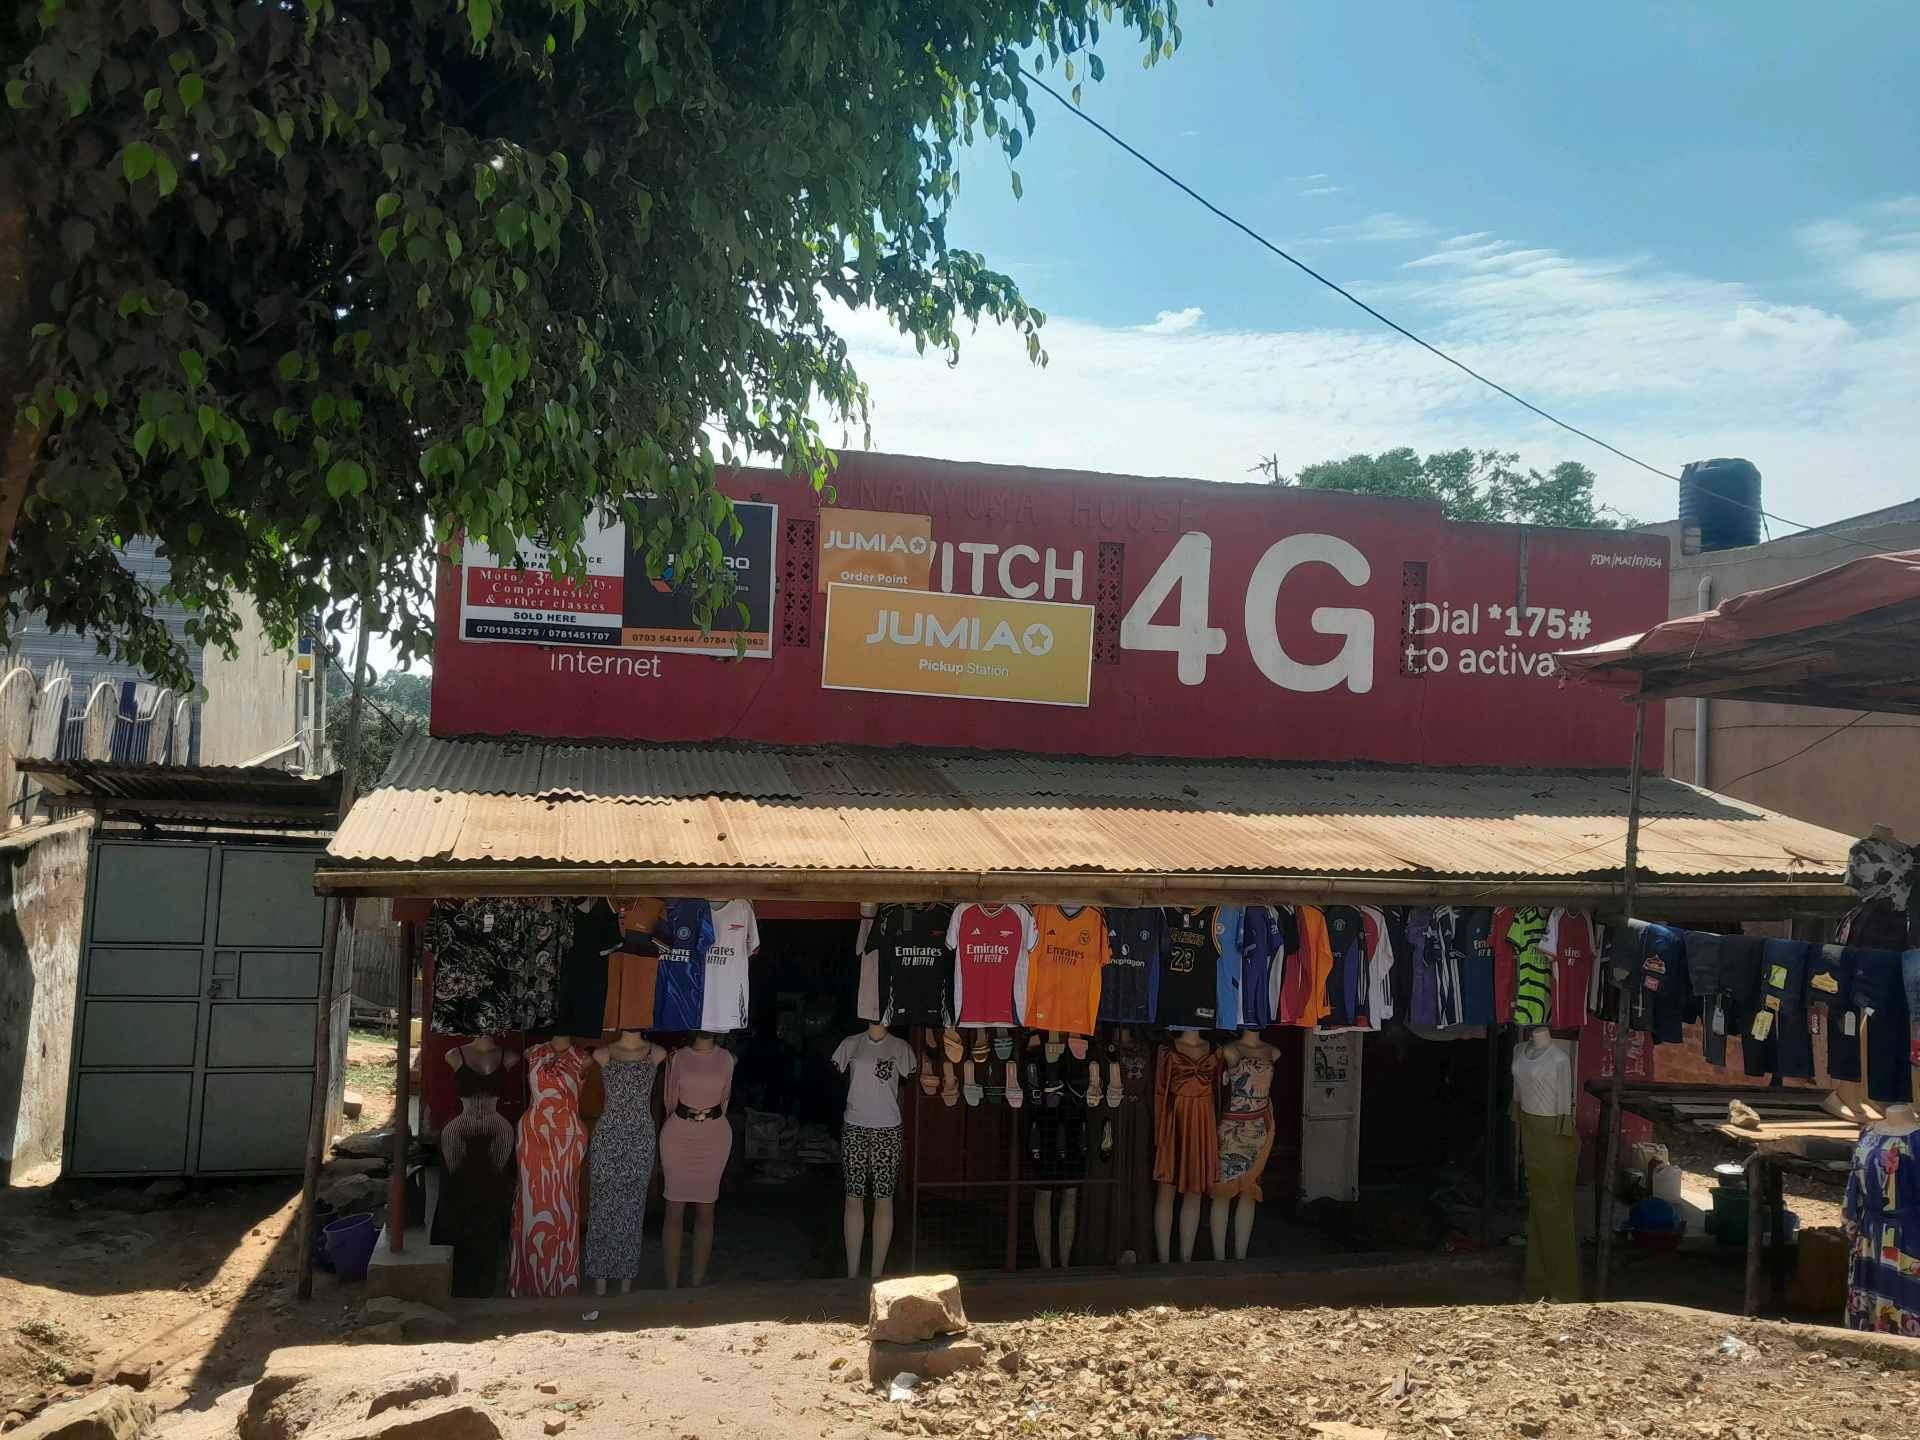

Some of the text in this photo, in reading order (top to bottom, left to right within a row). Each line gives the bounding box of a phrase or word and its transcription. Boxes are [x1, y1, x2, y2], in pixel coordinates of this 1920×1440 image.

[1071, 490, 1194, 534] HOUSE
[480, 570, 522, 583] Moto
[567, 575, 612, 590] Pty,
[840, 570, 909, 585] Order Point
[929, 540, 1085, 600] ITCH
[485, 594, 606, 611] & other classes
[1120, 531, 1375, 693] 4G
[513, 611, 577, 624] SOLD HERE
[1408, 601, 1479, 635] Dial
[866, 609, 1023, 655] JUMIA
[550, 651, 662, 679] internet
[919, 658, 1009, 677] Pickup Station
[1405, 643, 1564, 677] to activa
[895, 946, 942, 957] Emirates
[966, 943, 1009, 955] Emirates
[1107, 958, 1145, 968] napdragon
